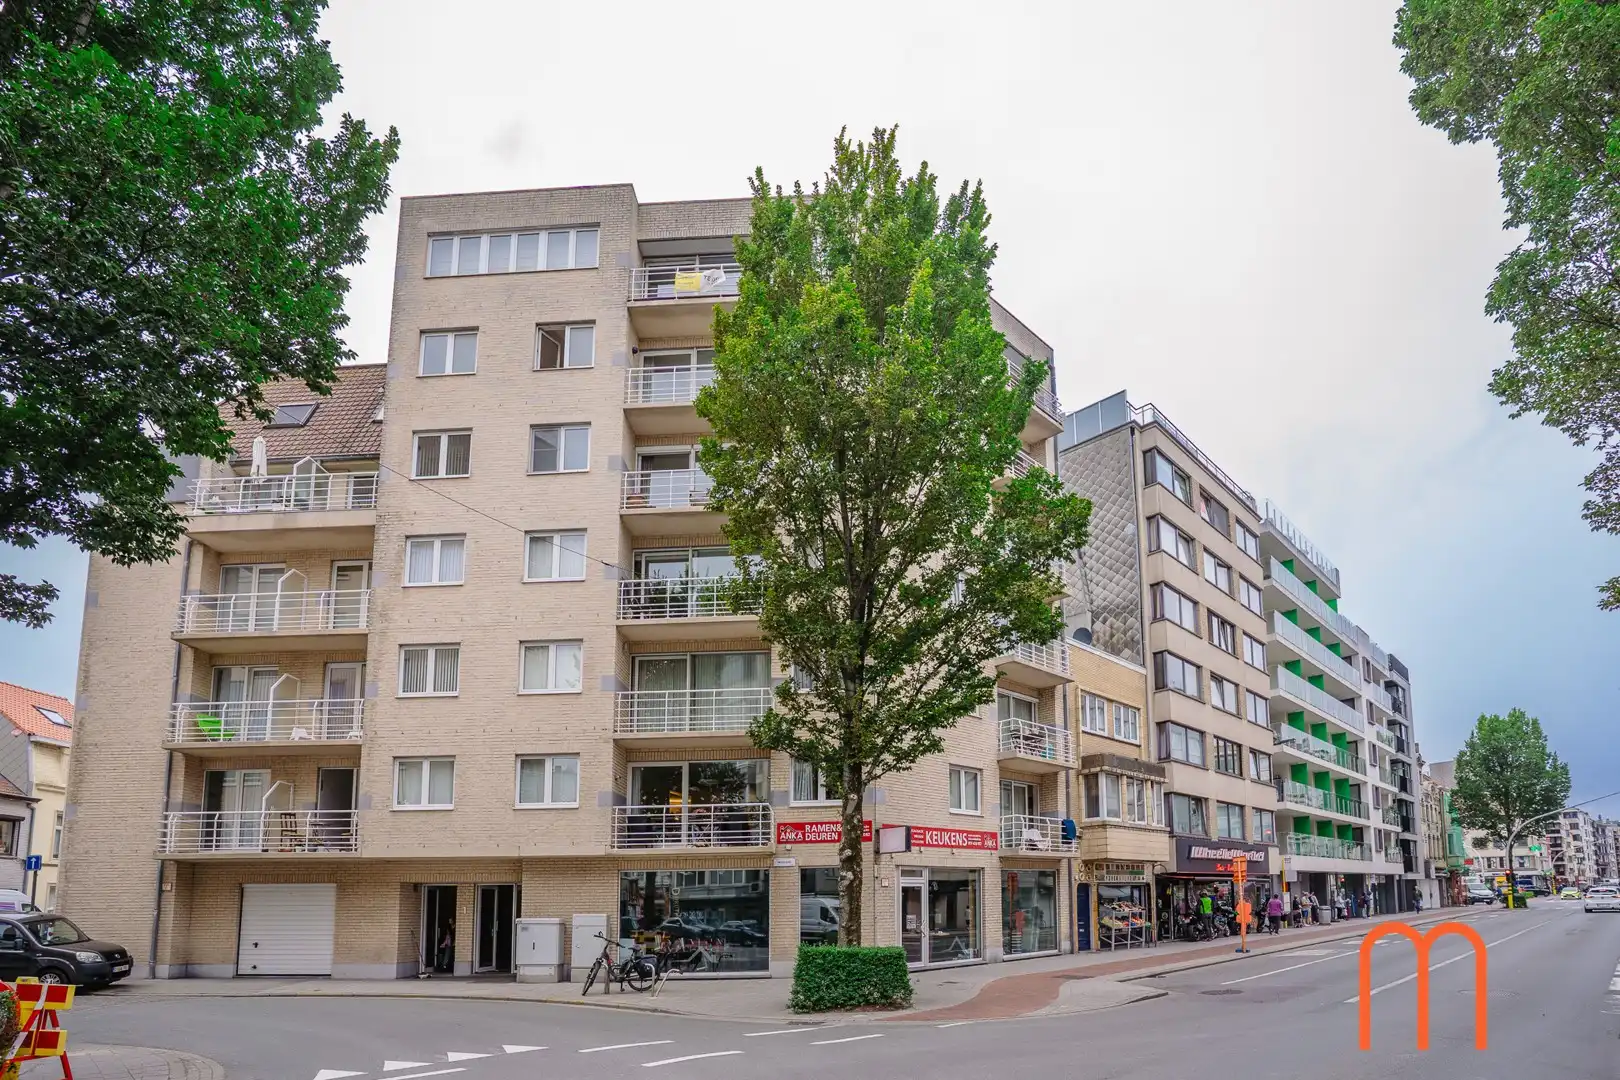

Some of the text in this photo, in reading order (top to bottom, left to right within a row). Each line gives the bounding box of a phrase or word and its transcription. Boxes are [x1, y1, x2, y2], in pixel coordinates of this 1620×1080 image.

[805, 824, 842, 833] RAMEN&
[780, 832, 803, 841] ANKA
[805, 833, 838, 841] DEUREN
[925, 830, 968, 847] KEUKENS
